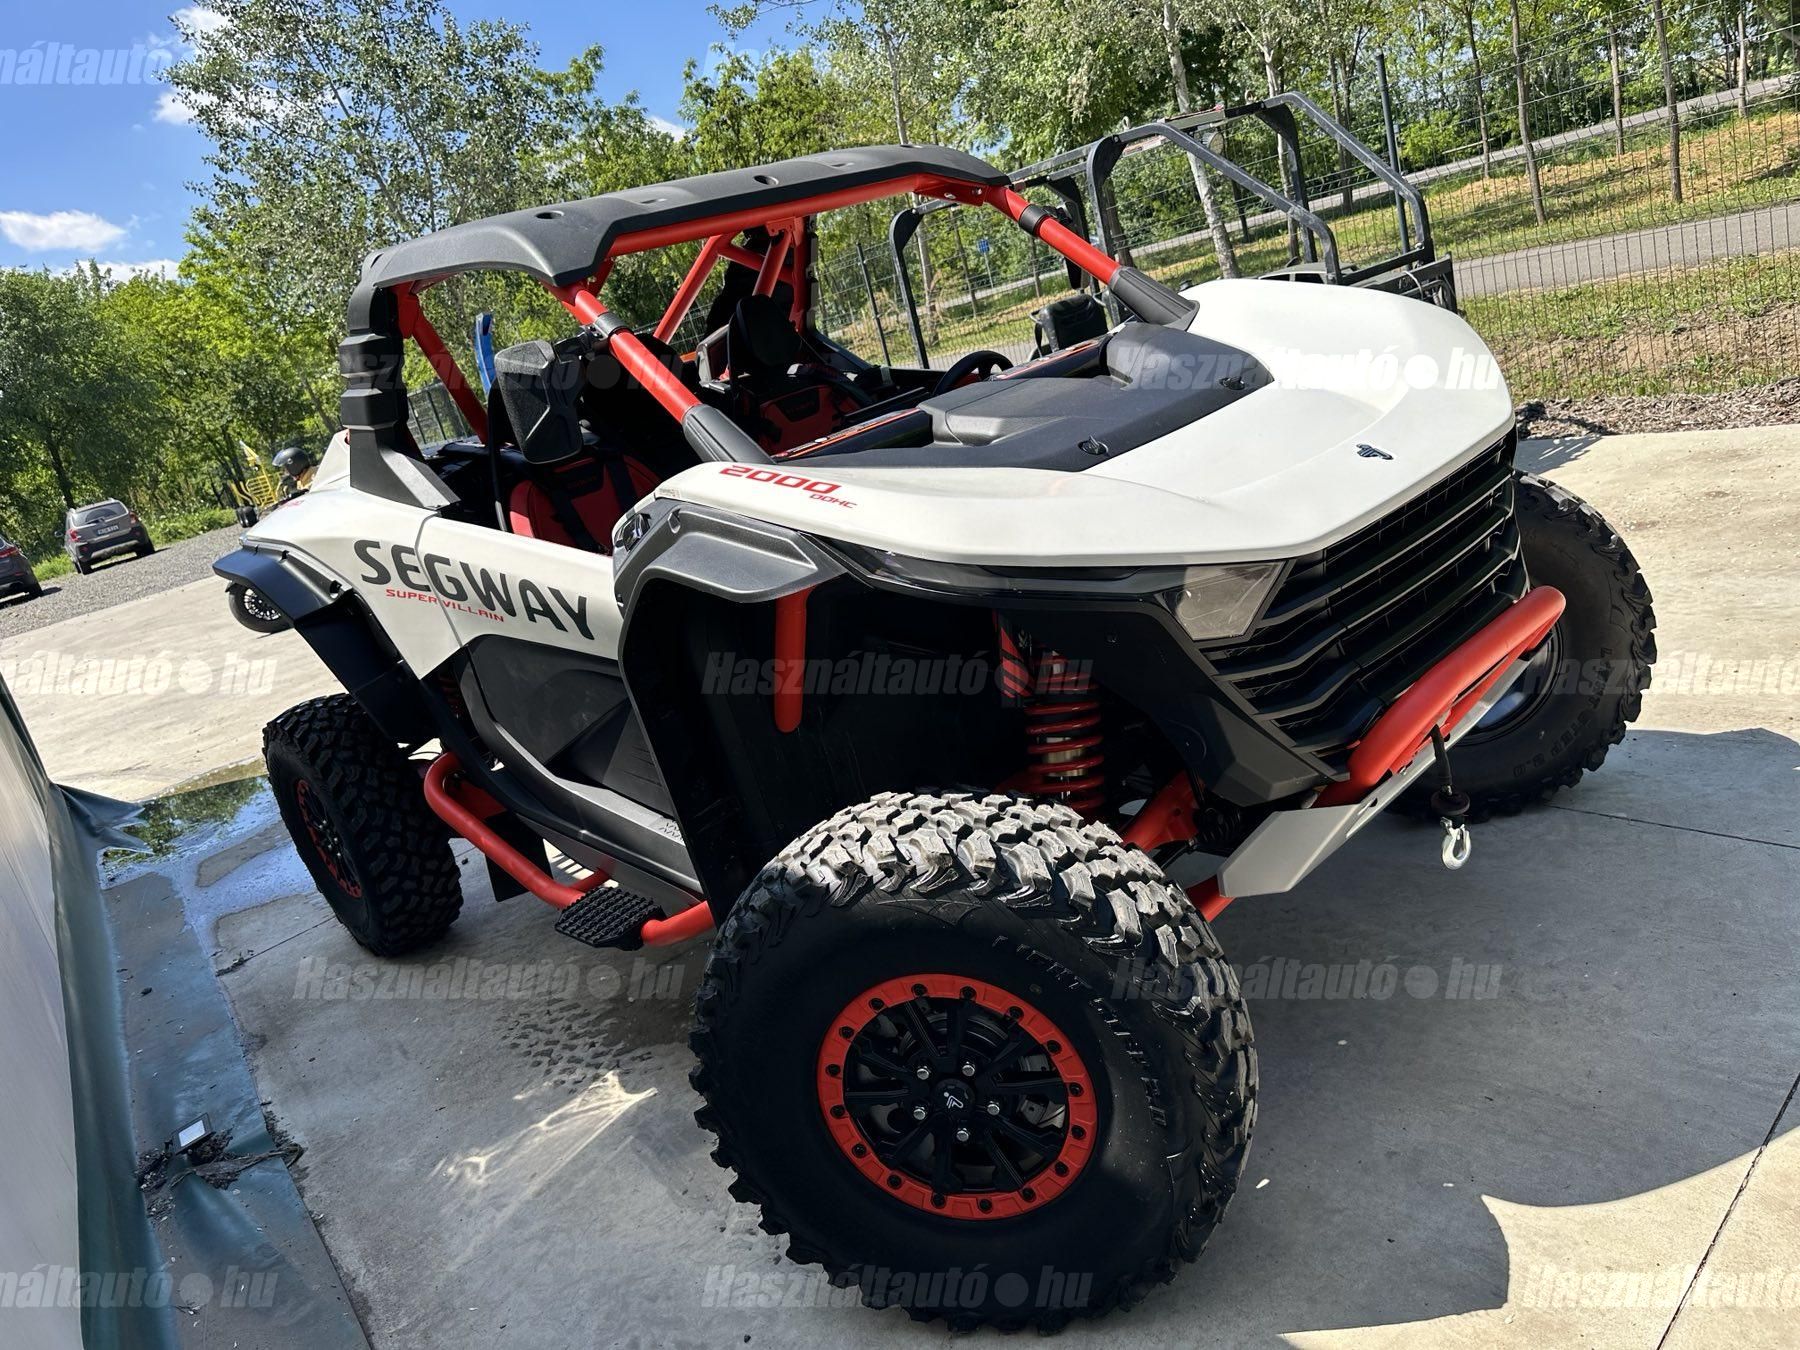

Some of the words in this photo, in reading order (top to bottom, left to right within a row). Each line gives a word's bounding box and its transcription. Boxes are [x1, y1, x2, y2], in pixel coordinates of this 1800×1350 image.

[719, 465, 842, 494] 2000
[809, 493, 857, 509] DOHC
[353, 539, 595, 641] SEGWAY
[386, 588, 437, 604] SUPER
[443, 600, 505, 623] VILLAIN
